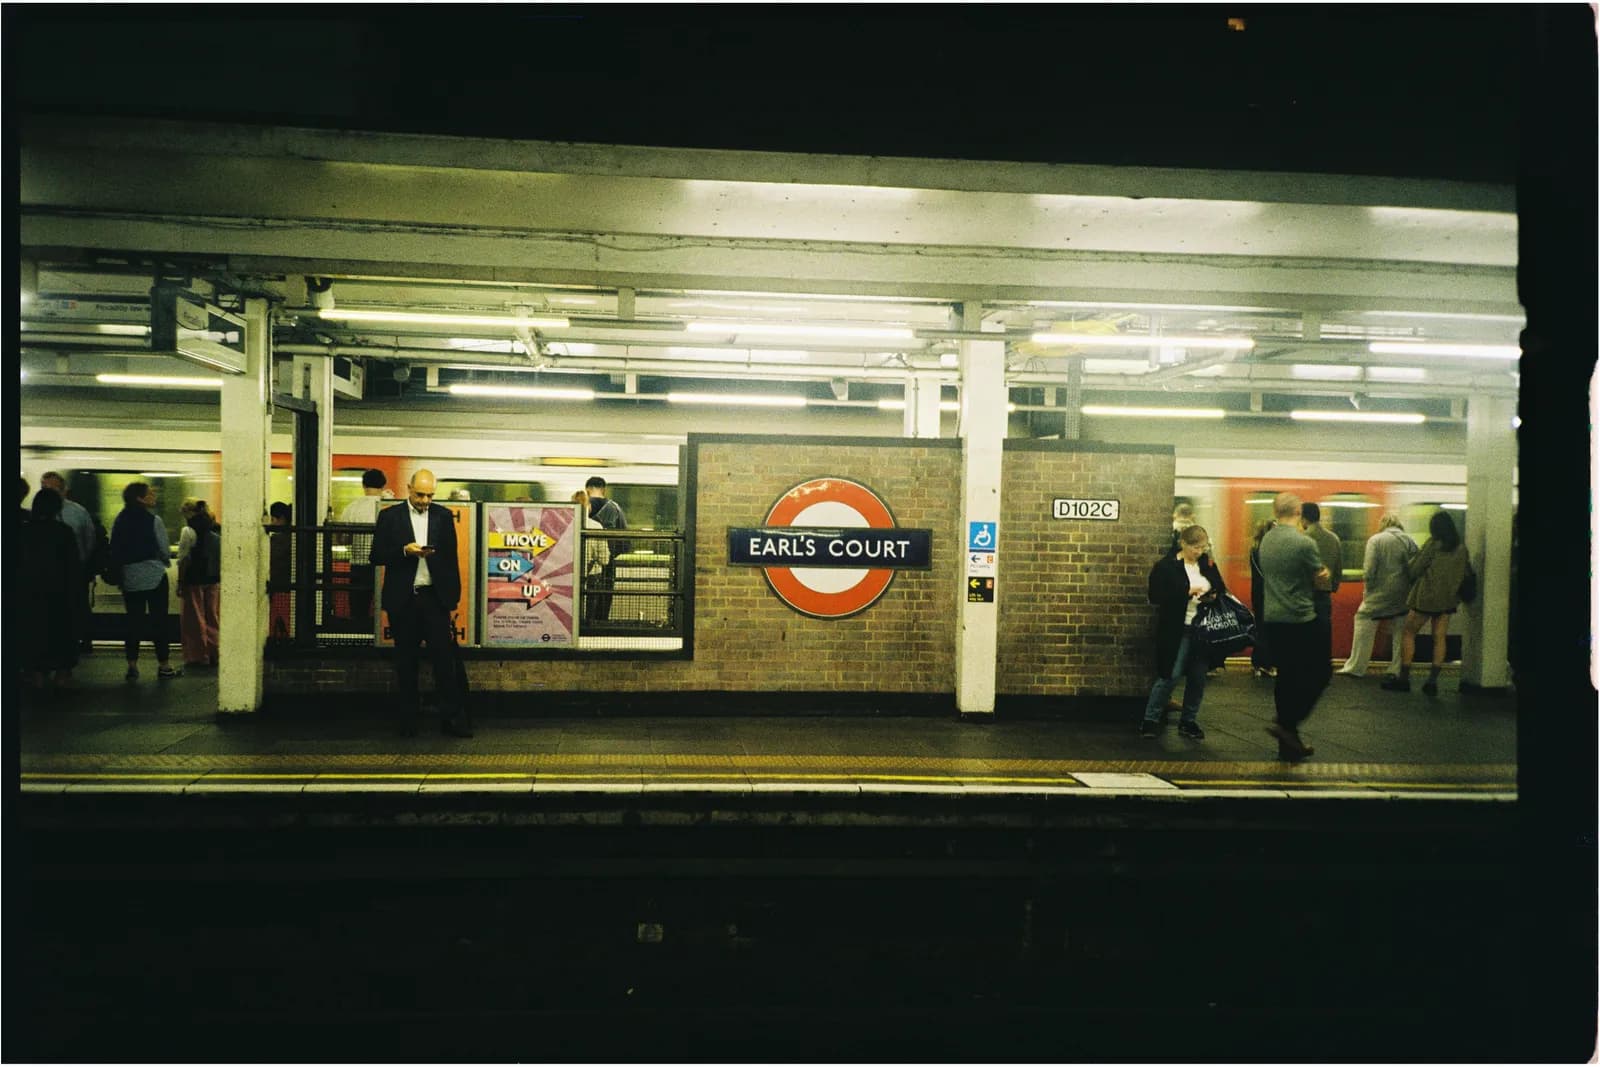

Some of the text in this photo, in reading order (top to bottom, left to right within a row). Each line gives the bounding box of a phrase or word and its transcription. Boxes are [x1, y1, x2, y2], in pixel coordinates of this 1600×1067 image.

[1059, 502, 1112, 517] D102C
[505, 534, 547, 547] MOVE
[749, 536, 910, 558] EARL'S COURT
[498, 558, 521, 572] ON
[523, 584, 541, 597] UP
